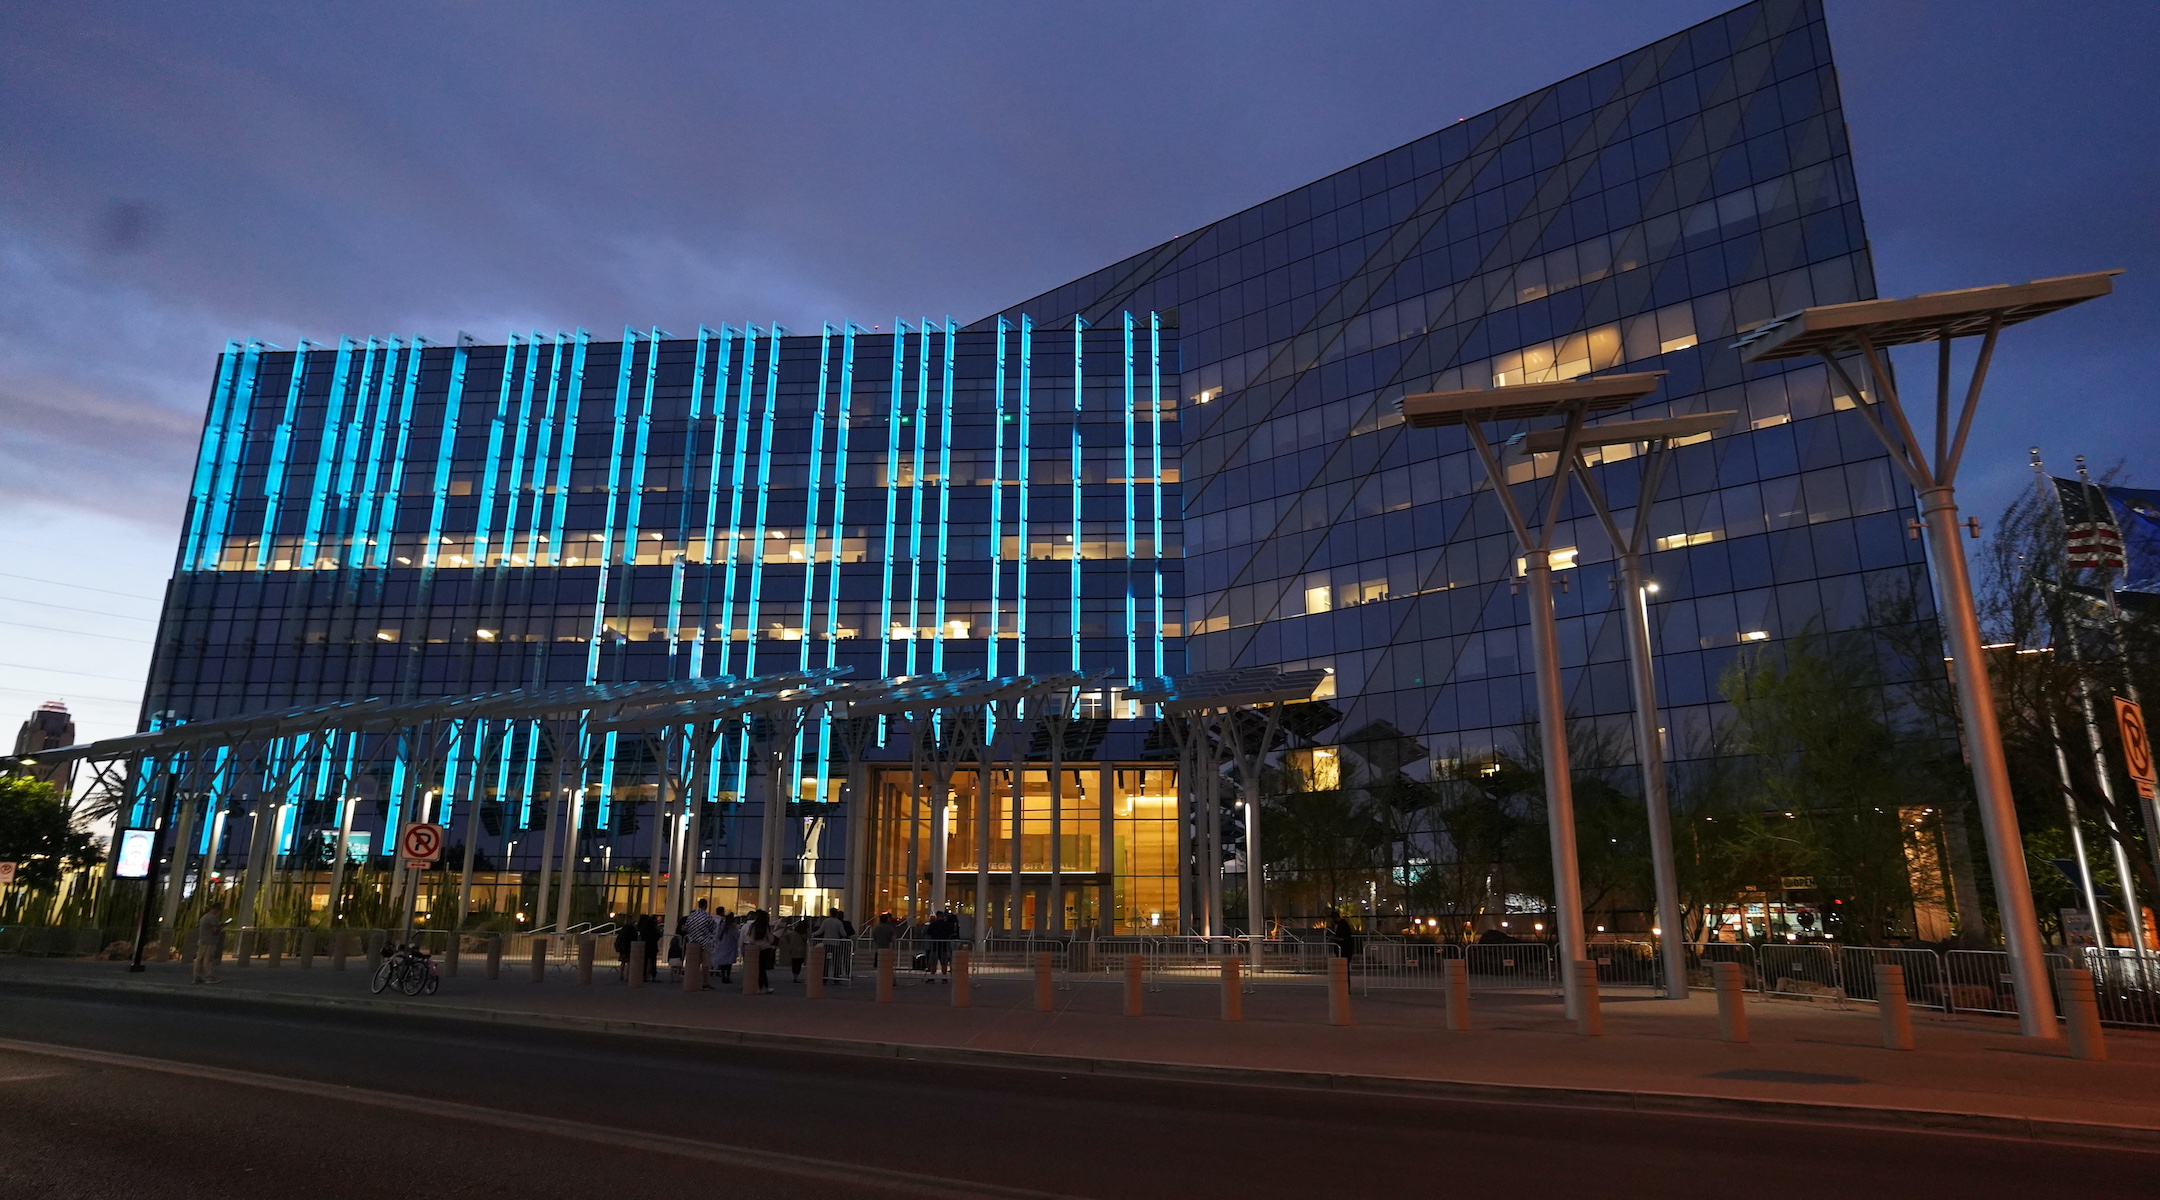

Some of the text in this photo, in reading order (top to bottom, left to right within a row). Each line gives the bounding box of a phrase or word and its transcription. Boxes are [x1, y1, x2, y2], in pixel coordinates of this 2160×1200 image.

[961, 862, 979, 870] LAS
[988, 862, 1013, 870] EGA
[1023, 862, 1045, 870] CITY
